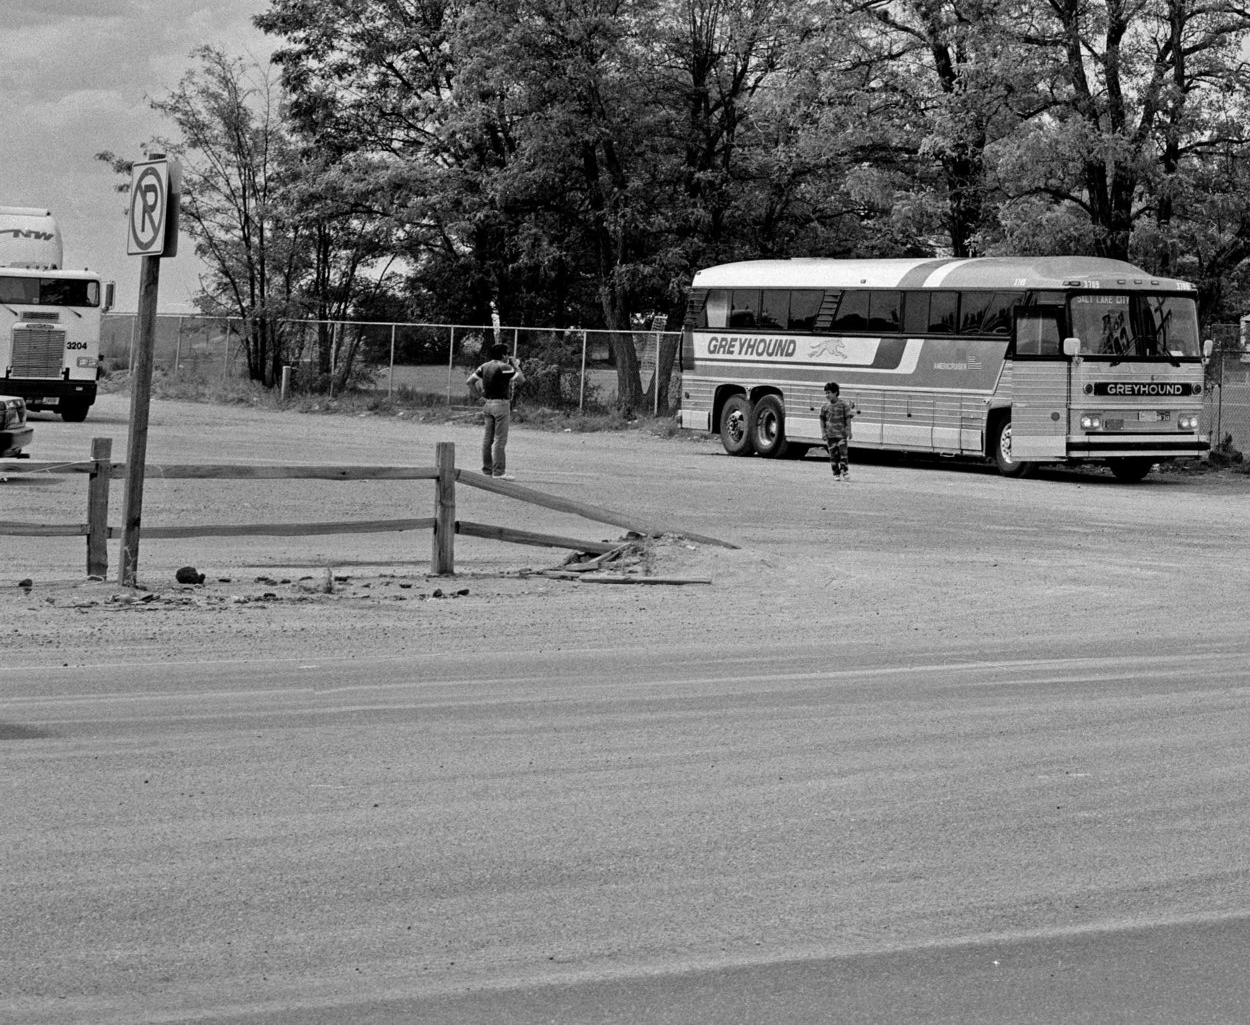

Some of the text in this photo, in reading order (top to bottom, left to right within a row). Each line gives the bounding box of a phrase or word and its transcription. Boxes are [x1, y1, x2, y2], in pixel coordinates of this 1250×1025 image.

[67, 342, 88, 350] 3204
[708, 336, 797, 357] GREYHOUND
[1107, 384, 1183, 394] GREYHOUND
